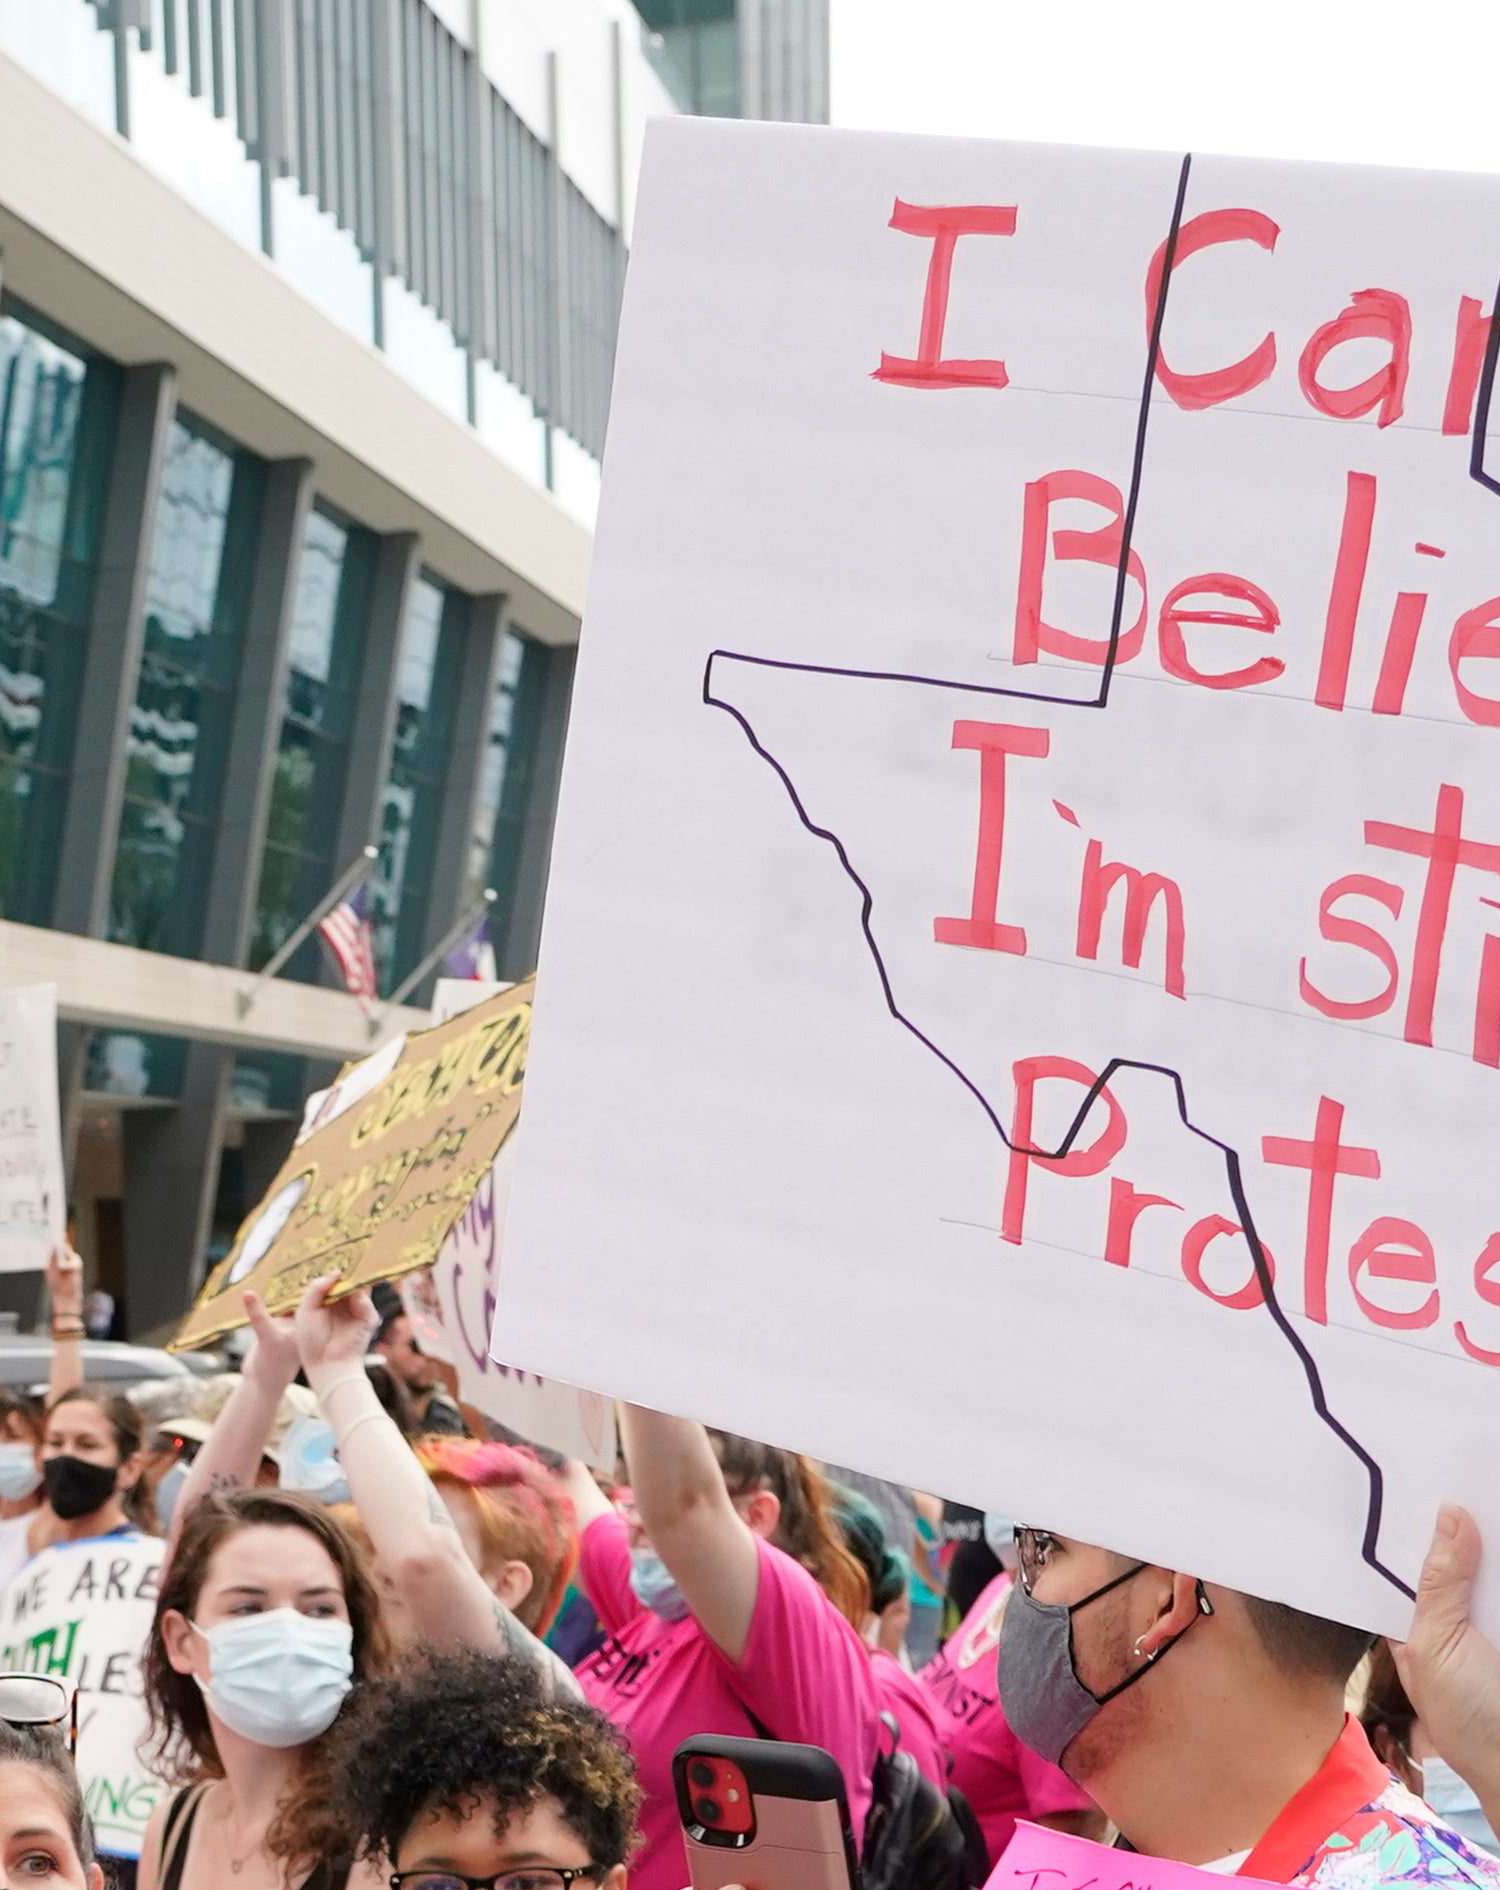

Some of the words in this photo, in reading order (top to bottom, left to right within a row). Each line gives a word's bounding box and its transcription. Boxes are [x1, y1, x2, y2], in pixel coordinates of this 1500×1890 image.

[870, 197, 1018, 389] I
[933, 718, 1187, 1001] I'm
[69, 1557, 161, 1602] ARE
